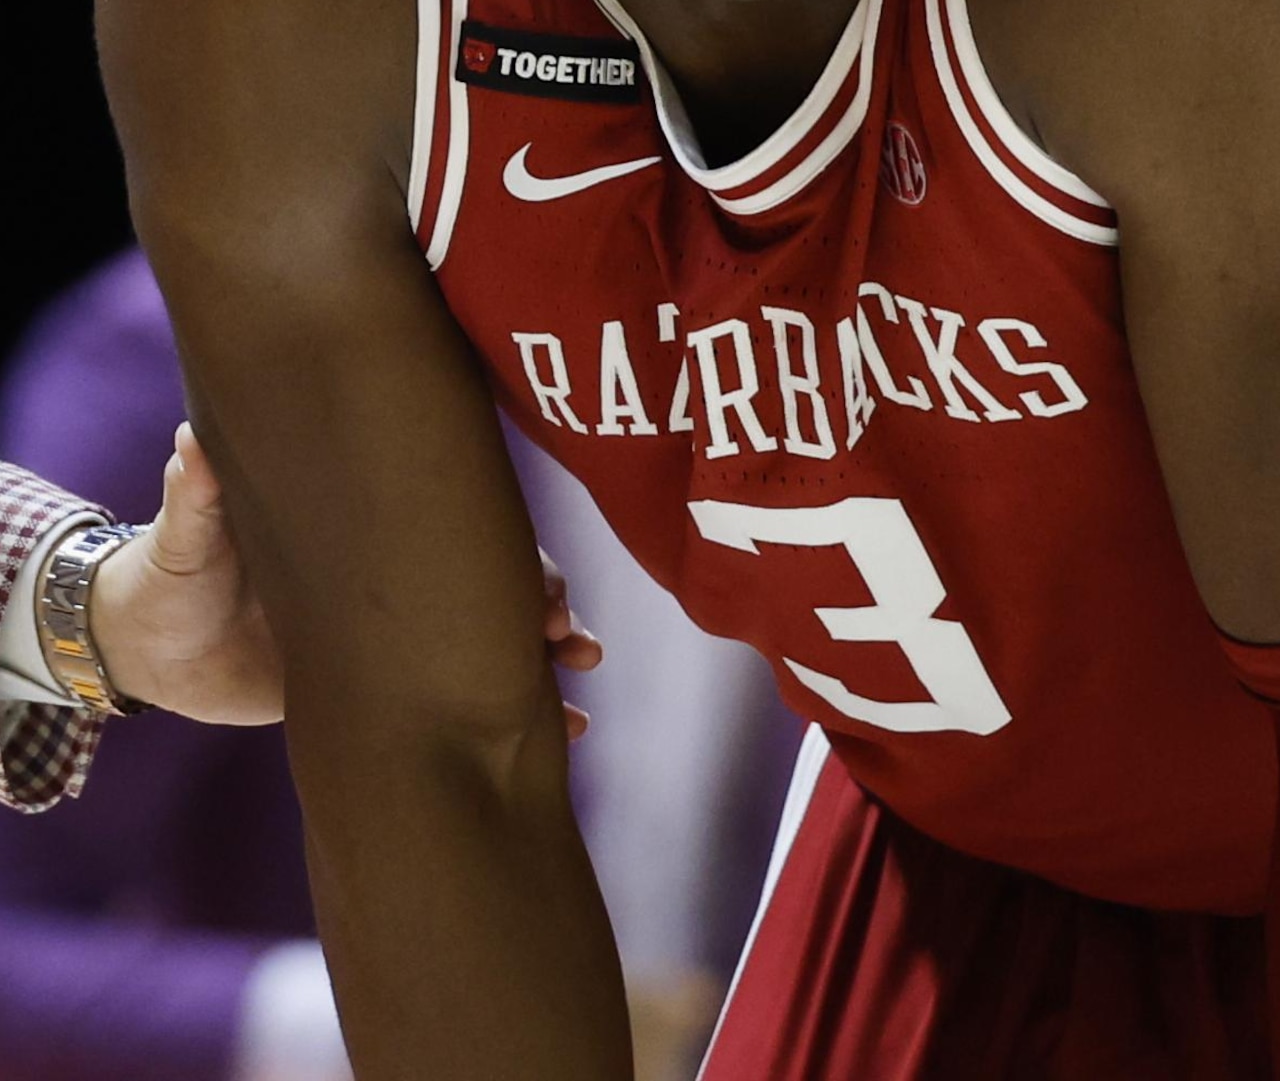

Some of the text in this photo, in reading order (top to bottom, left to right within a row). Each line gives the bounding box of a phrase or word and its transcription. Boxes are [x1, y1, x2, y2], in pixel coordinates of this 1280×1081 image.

[497, 48, 635, 86] TOGETHER
[511, 281, 1089, 460] RAZRBACKS
[686, 496, 1013, 736] 3
